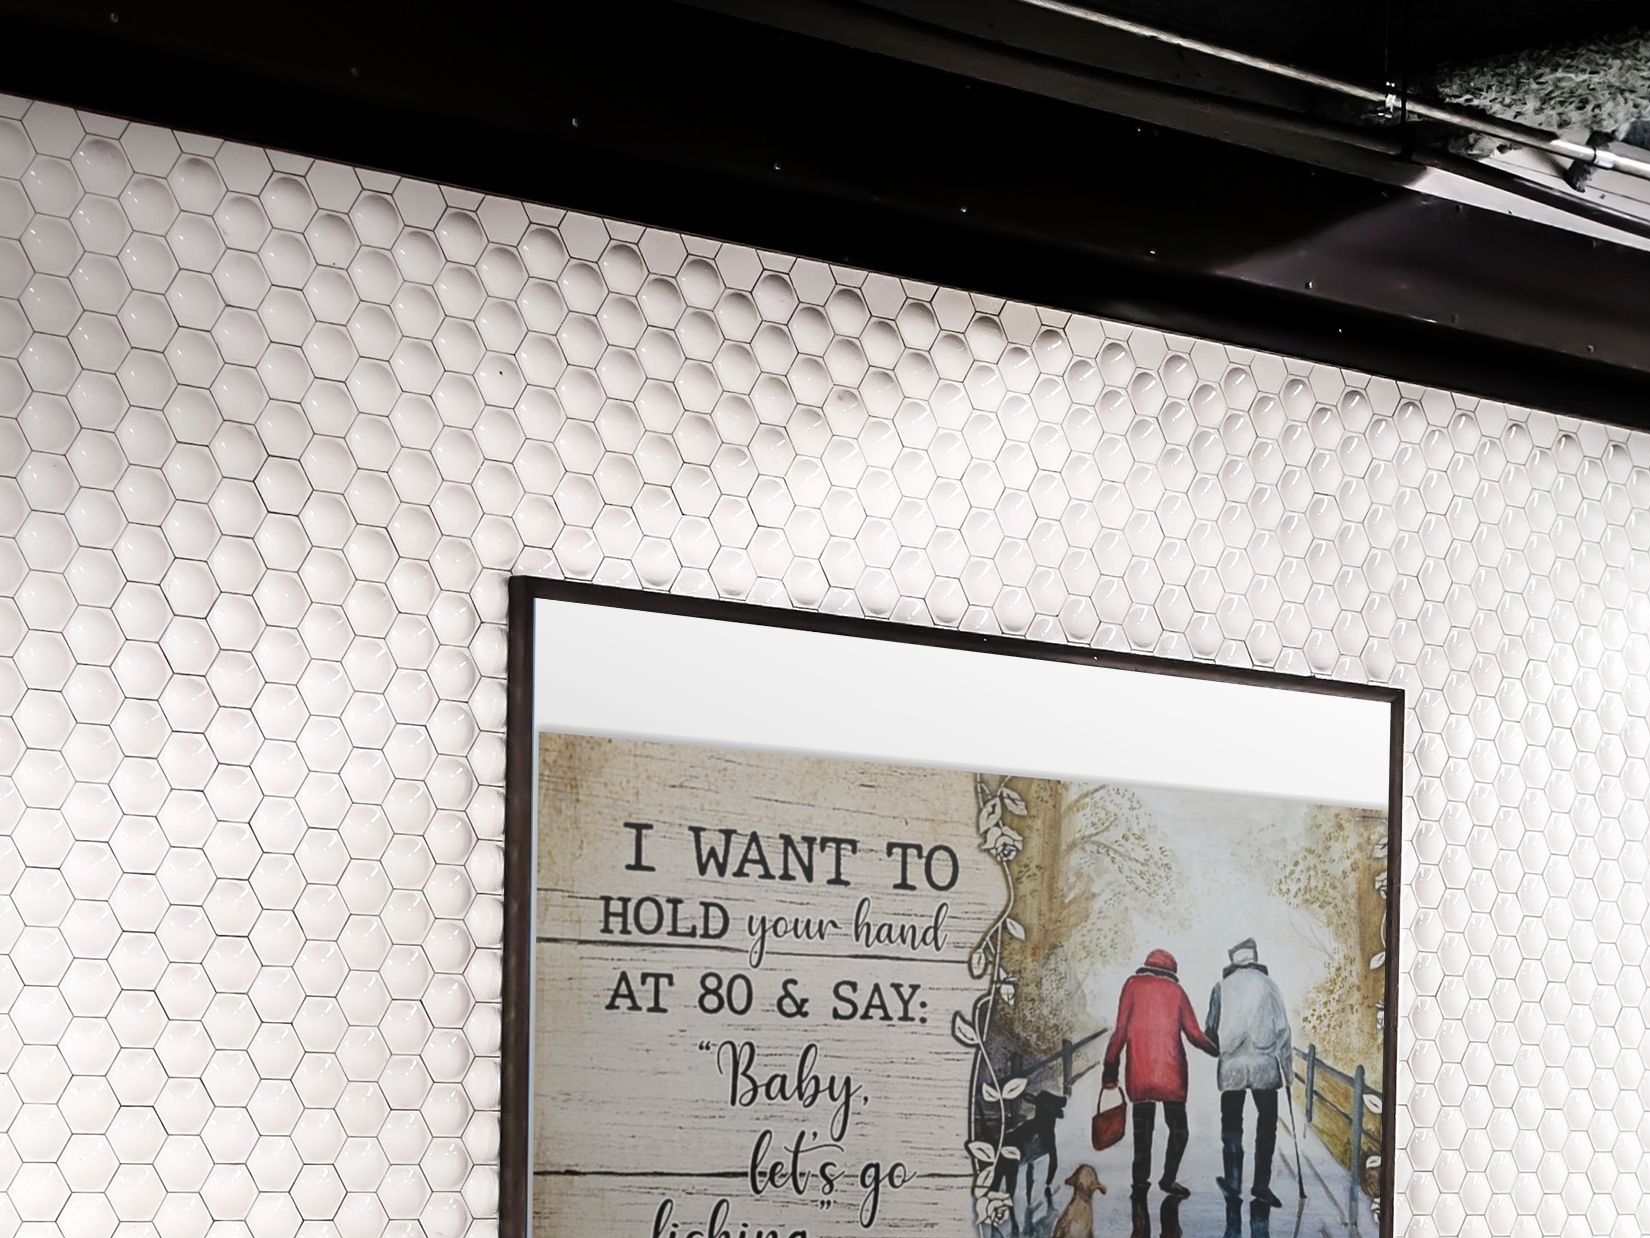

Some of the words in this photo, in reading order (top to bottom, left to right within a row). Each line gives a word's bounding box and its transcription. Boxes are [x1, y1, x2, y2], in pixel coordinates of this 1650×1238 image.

[623, 822, 656, 872] I
[688, 826, 857, 886] WANT
[886, 842, 960, 891] TO
[600, 896, 730, 939] HOLD
[748, 912, 842, 968] your
[853, 897, 949, 951] hand
[605, 971, 674, 1013] AT
[699, 972, 753, 1015] 80
[776, 979, 809, 1018] &
[832, 981, 928, 1024] SAY:
[750, 1129, 844, 1195] let's
[860, 1161, 916, 1228] go
